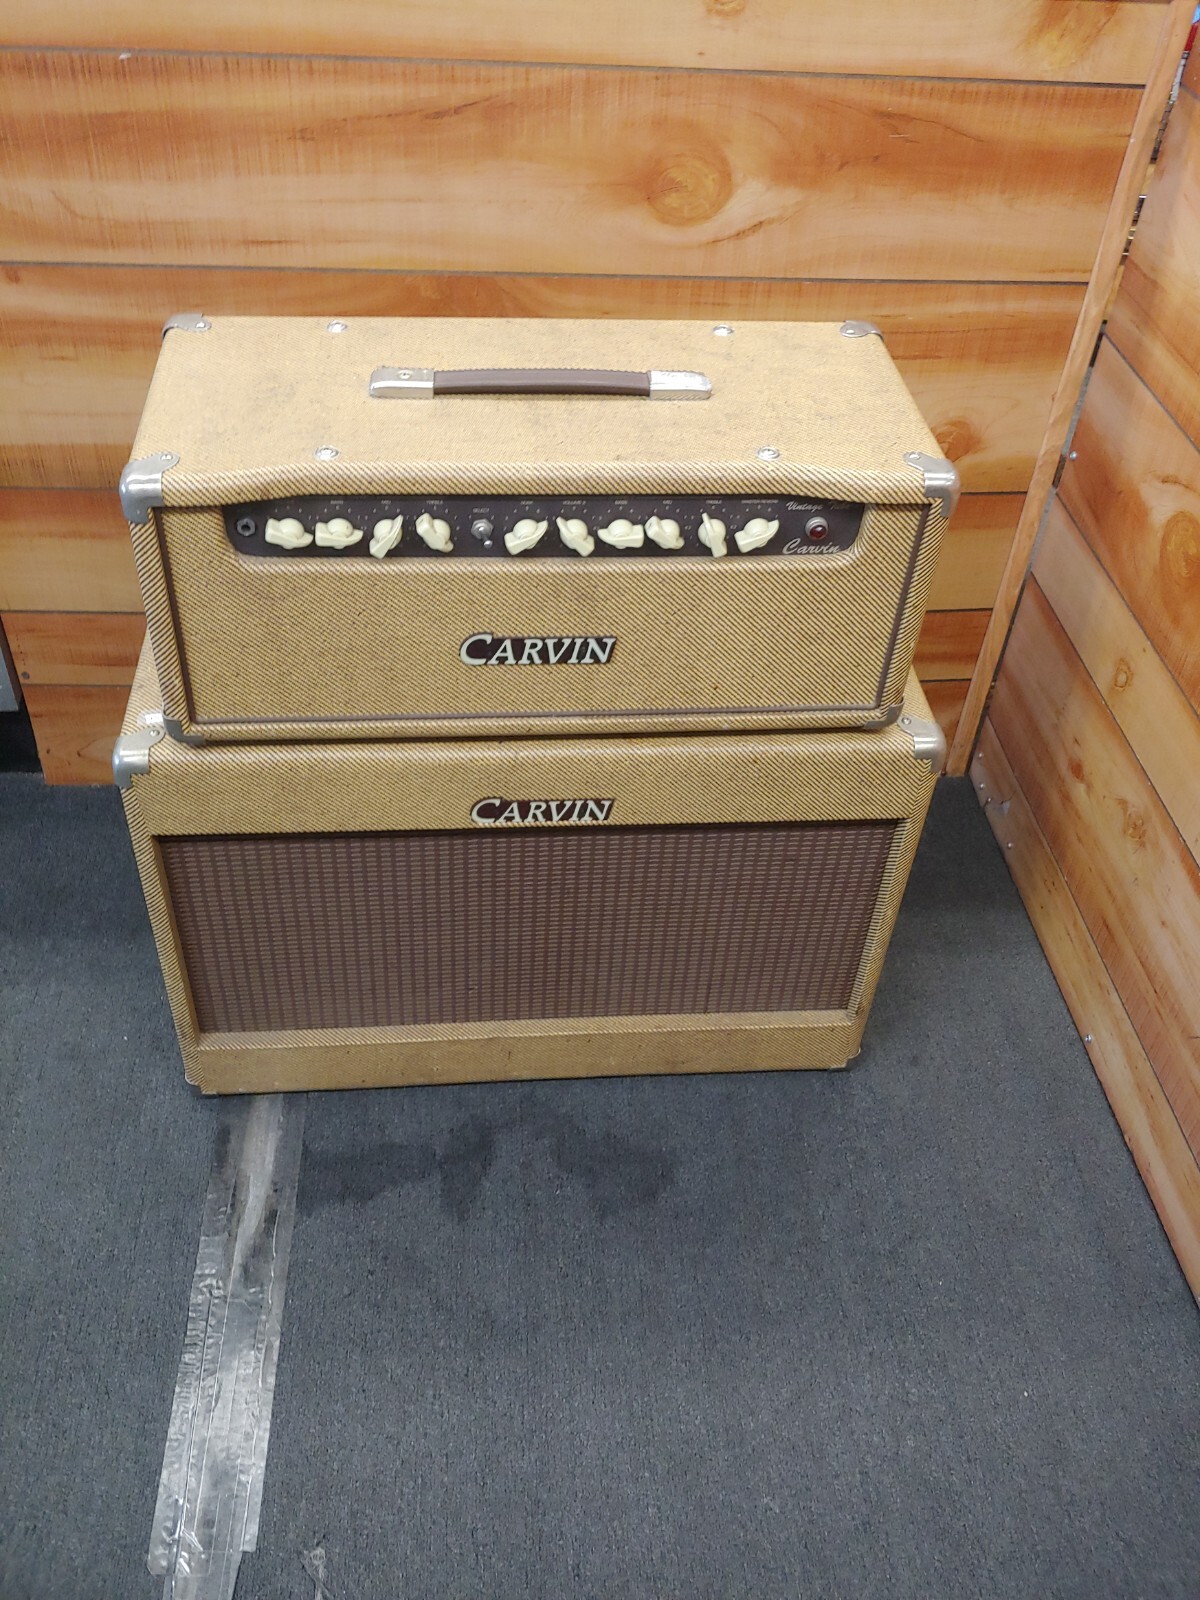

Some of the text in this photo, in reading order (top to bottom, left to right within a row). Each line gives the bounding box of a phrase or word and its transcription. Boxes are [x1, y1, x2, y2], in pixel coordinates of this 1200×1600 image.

[786, 501, 823, 512] Vintage
[782, 538, 840, 555] Carvin
[460, 633, 616, 666] CARVIN
[471, 799, 612, 823] CARVIN
